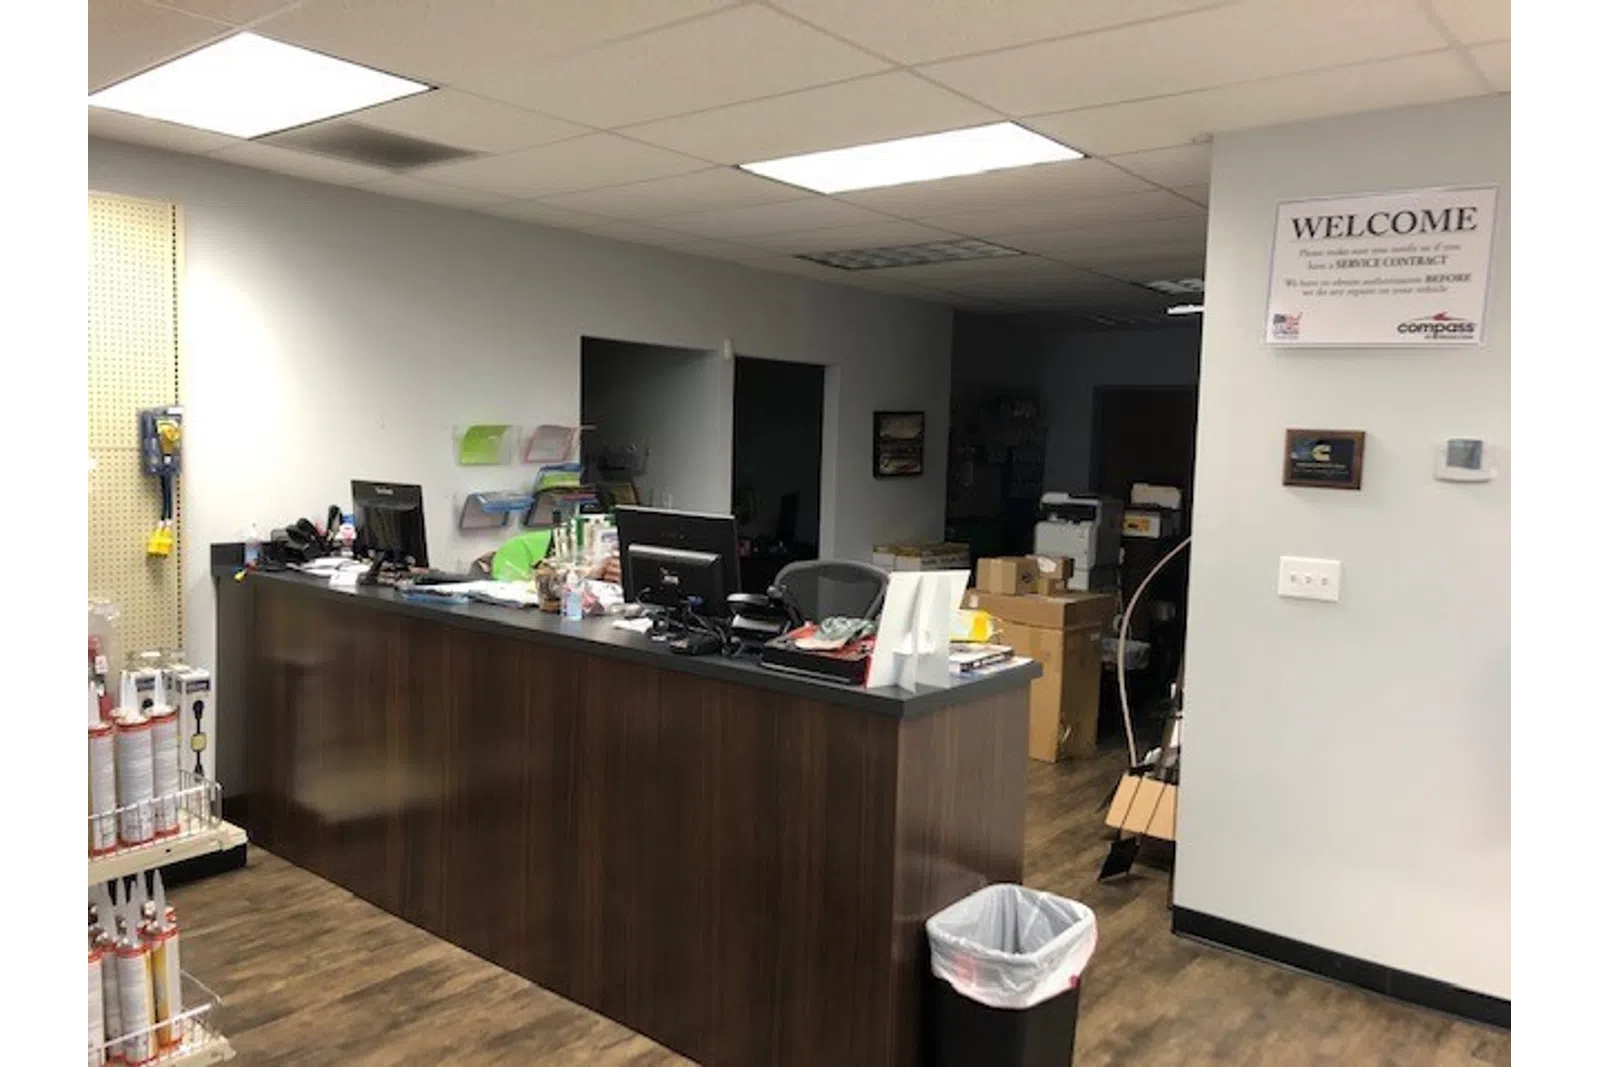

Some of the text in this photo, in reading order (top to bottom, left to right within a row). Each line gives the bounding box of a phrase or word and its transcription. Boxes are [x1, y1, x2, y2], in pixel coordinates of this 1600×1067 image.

[1291, 206, 1478, 239] WELCOME
[1336, 257, 1380, 269] SERVICE
[1382, 255, 1448, 268] CONTRACT
[1424, 273, 1471, 283] BEFORE
[1397, 322, 1475, 339] compass
